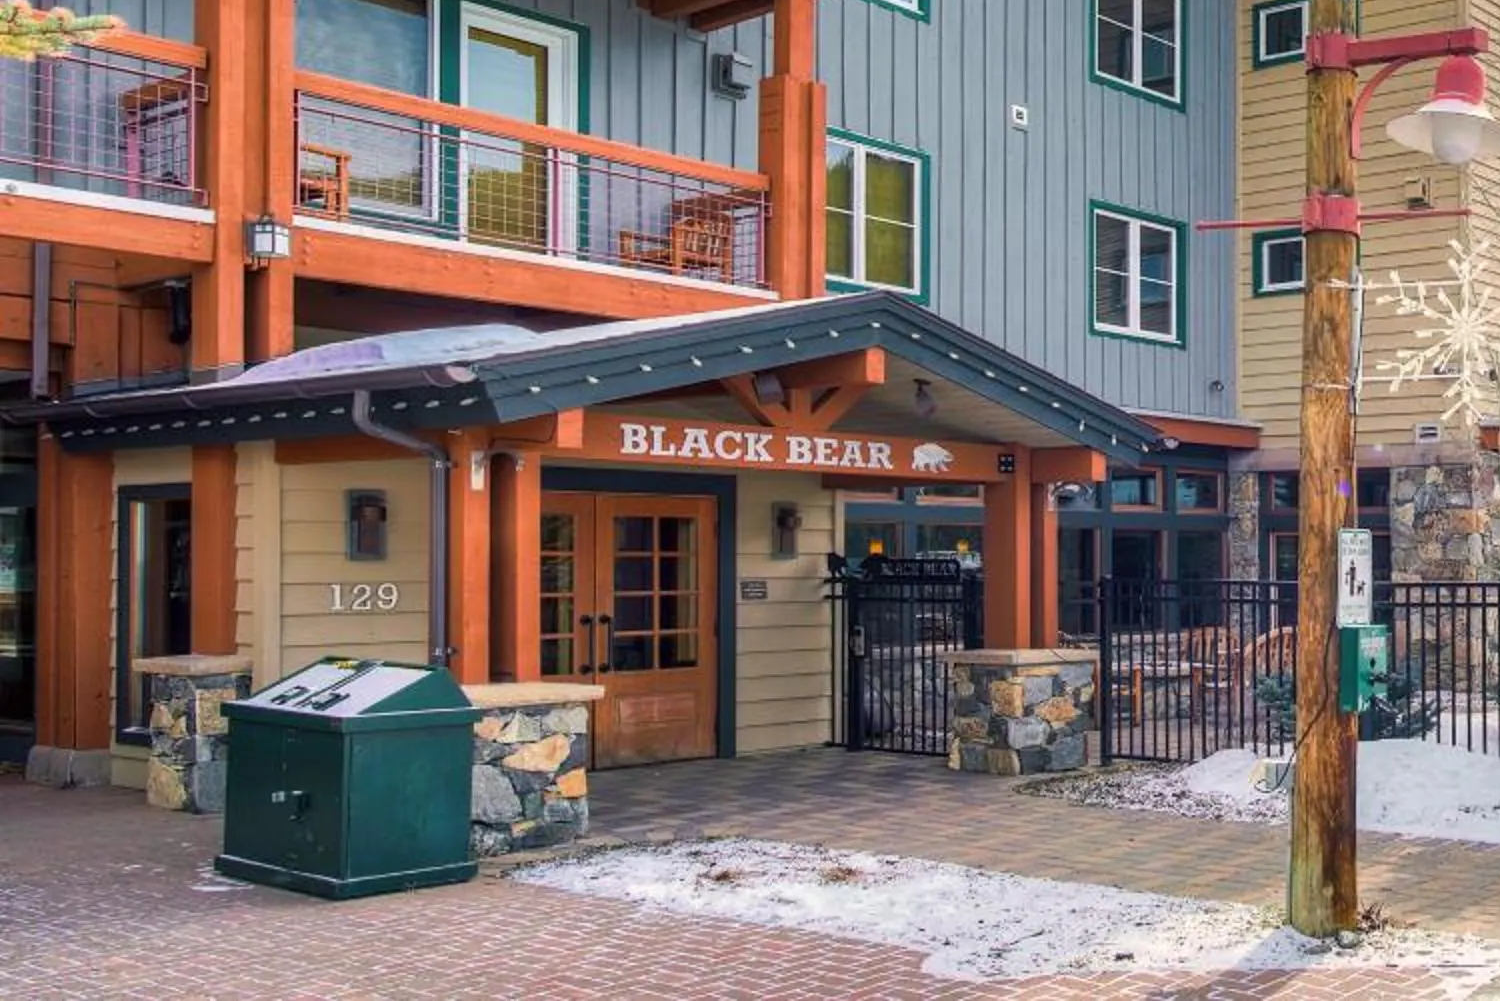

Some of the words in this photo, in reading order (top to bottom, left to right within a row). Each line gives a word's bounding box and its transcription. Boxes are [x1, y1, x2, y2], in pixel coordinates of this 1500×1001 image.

[620, 423, 774, 462] BLACK
[786, 435, 895, 470] BEAR
[330, 583, 398, 610] 129
